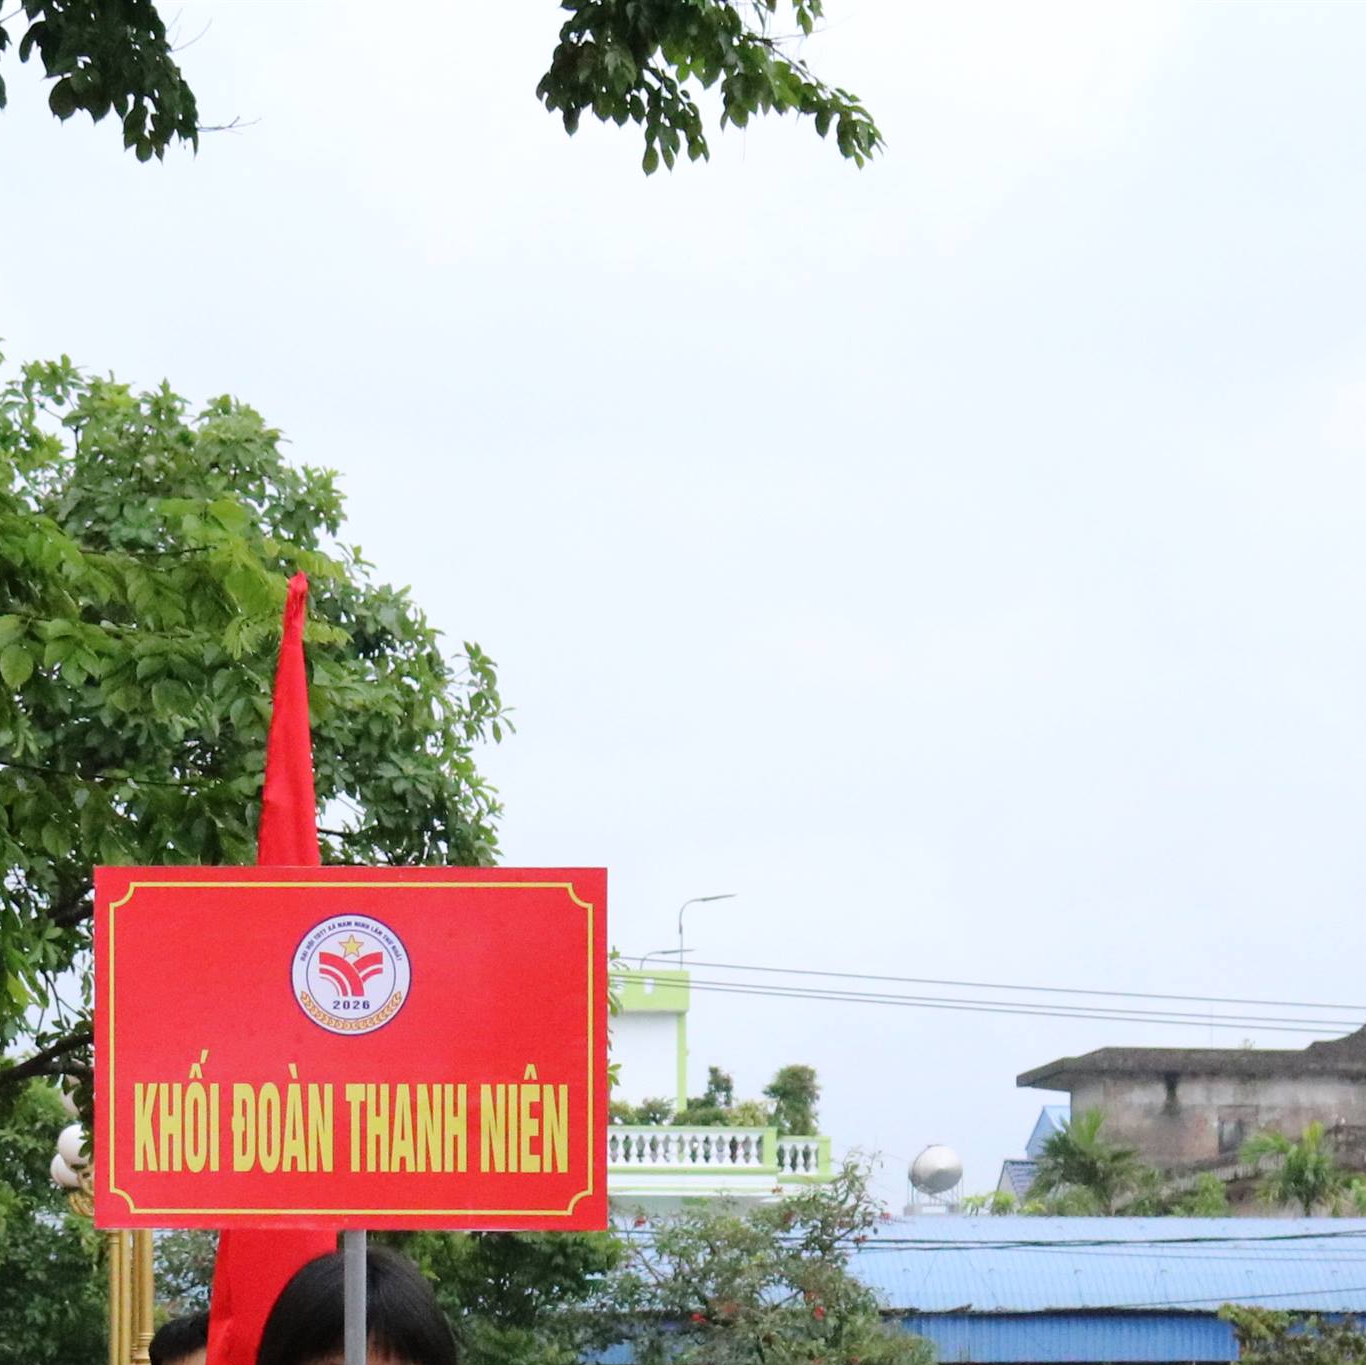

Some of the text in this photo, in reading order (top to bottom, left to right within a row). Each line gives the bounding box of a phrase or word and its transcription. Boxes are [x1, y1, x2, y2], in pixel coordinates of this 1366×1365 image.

[333, 1000, 370, 1010] 2026
[134, 1048, 569, 1174] KHỐI ĐOÀN THANH NIÊN
